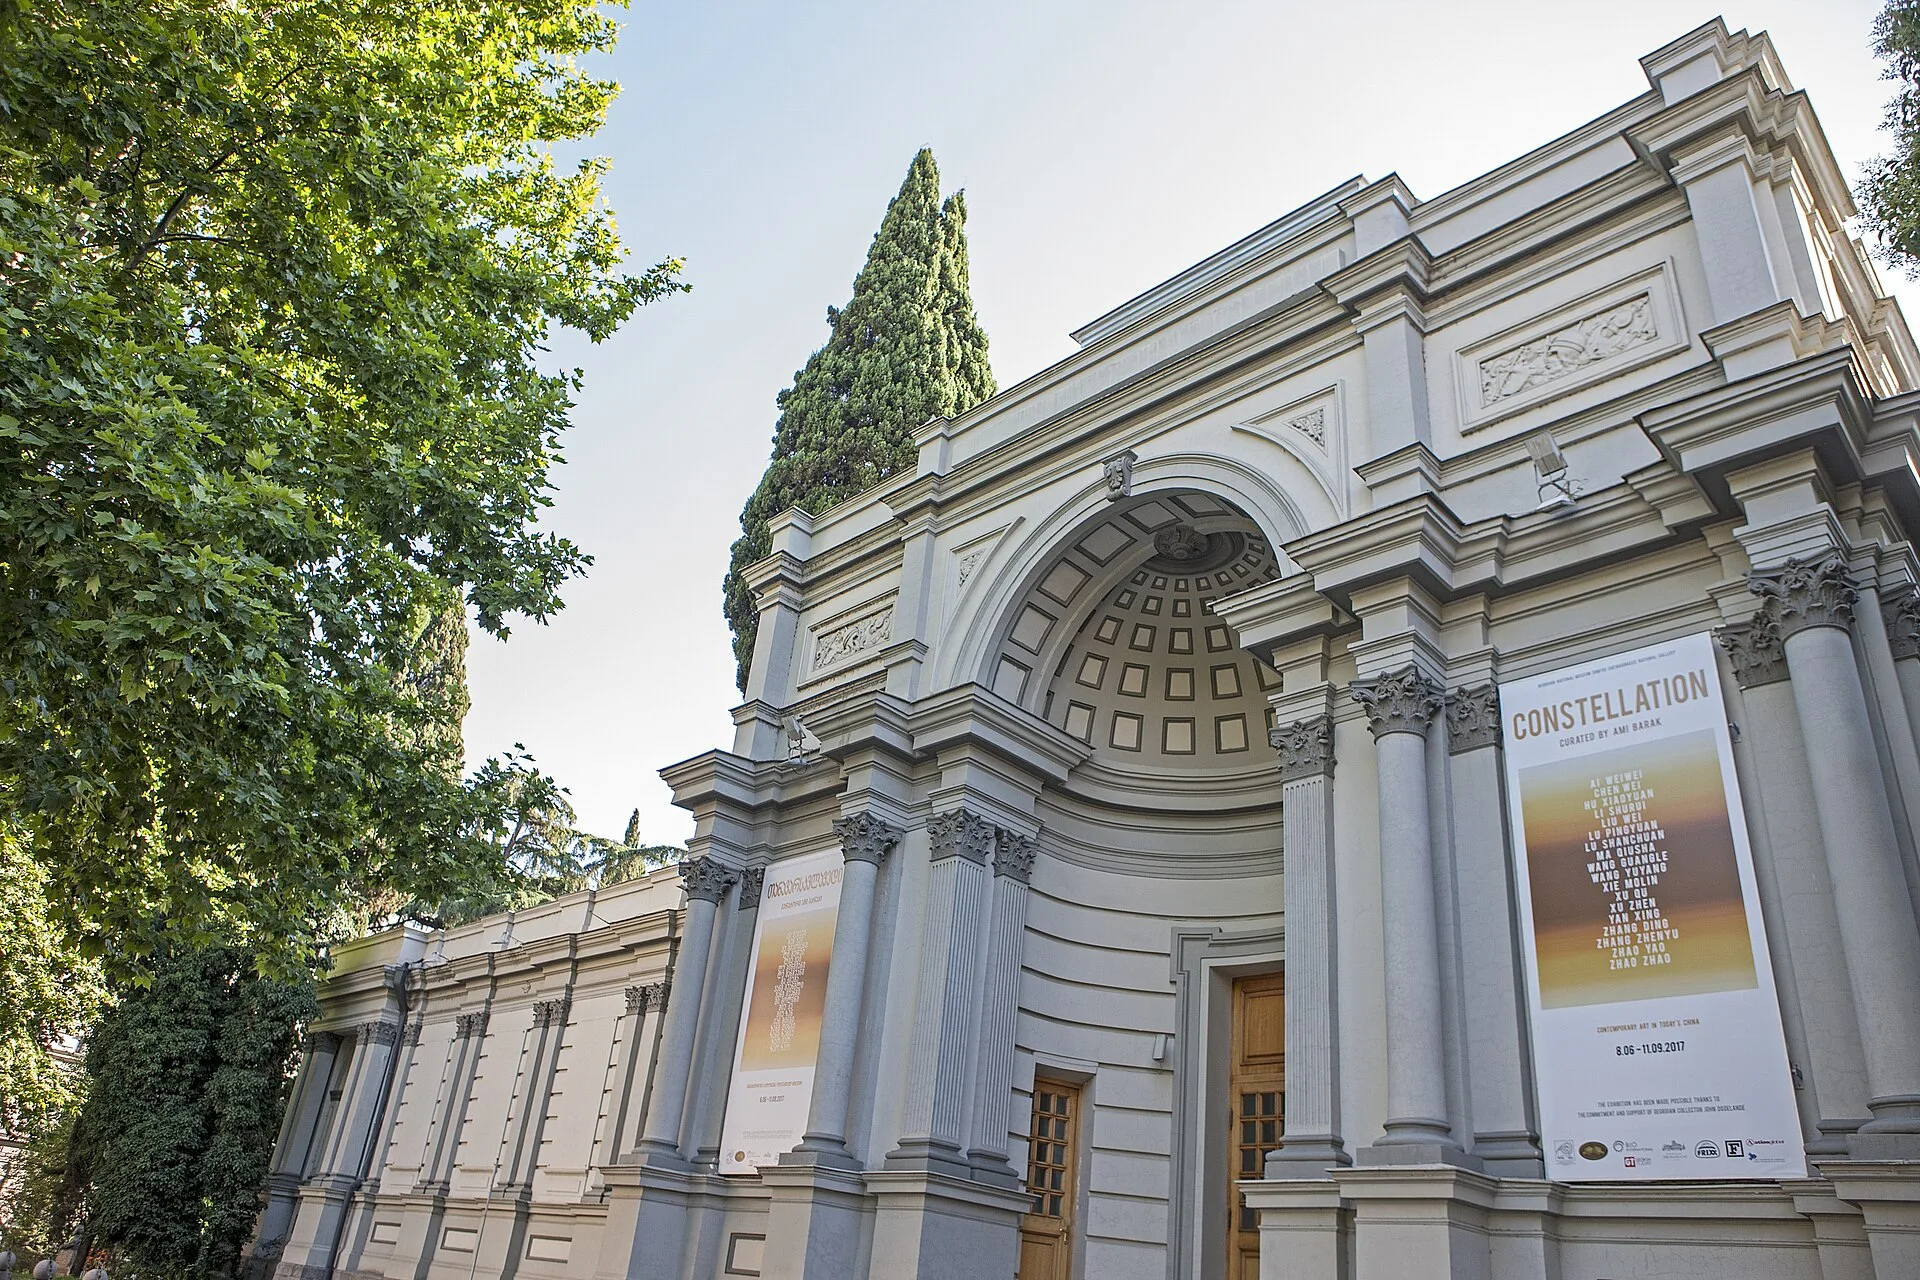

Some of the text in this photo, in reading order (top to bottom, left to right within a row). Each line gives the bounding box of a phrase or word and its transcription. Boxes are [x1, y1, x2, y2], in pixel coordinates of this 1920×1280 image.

[1513, 669, 1708, 740] CONSTELLATION
[1560, 718, 1662, 747] CURATED BY AMI BARAK
[1591, 770, 1642, 788] AI WEIWEI
[1594, 781, 1641, 798] CHEN WEI
[1584, 789, 1654, 810] HU XIAOYUAN
[1594, 801, 1646, 818] LI SHURUI
[1601, 812, 1642, 828] LIU WEI
[1588, 820, 1658, 840] LU PINGYUAN
[1585, 830, 1664, 852] LU SHANCHUAN
[1596, 843, 1656, 860] MA QIUSHA
[1587, 851, 1668, 873] WANG GUANGLE
[1591, 863, 1667, 883] WANG YUYANG
[1603, 875, 1658, 892] XIE MOLIN
[1615, 891, 1628, 901] XU
[1610, 898, 1656, 913] XU ZHEN
[1609, 909, 1660, 924] YAN XING
[1603, 919, 1669, 936] ZHANG DING
[1596, 929, 1679, 948] ZHANG ZHENYU
[1612, 943, 1665, 958] ZHAO YAO
[1610, 953, 1670, 970] ZHAO ZHAO
[1597, 1024, 1637, 1034] CONTEMPORARY
[1640, 1022, 1649, 1030] ART
[1660, 1020, 1680, 1028] TODAY'S
[1729, 1144, 1739, 1154] F
[1625, 1158, 1634, 1166] GT
